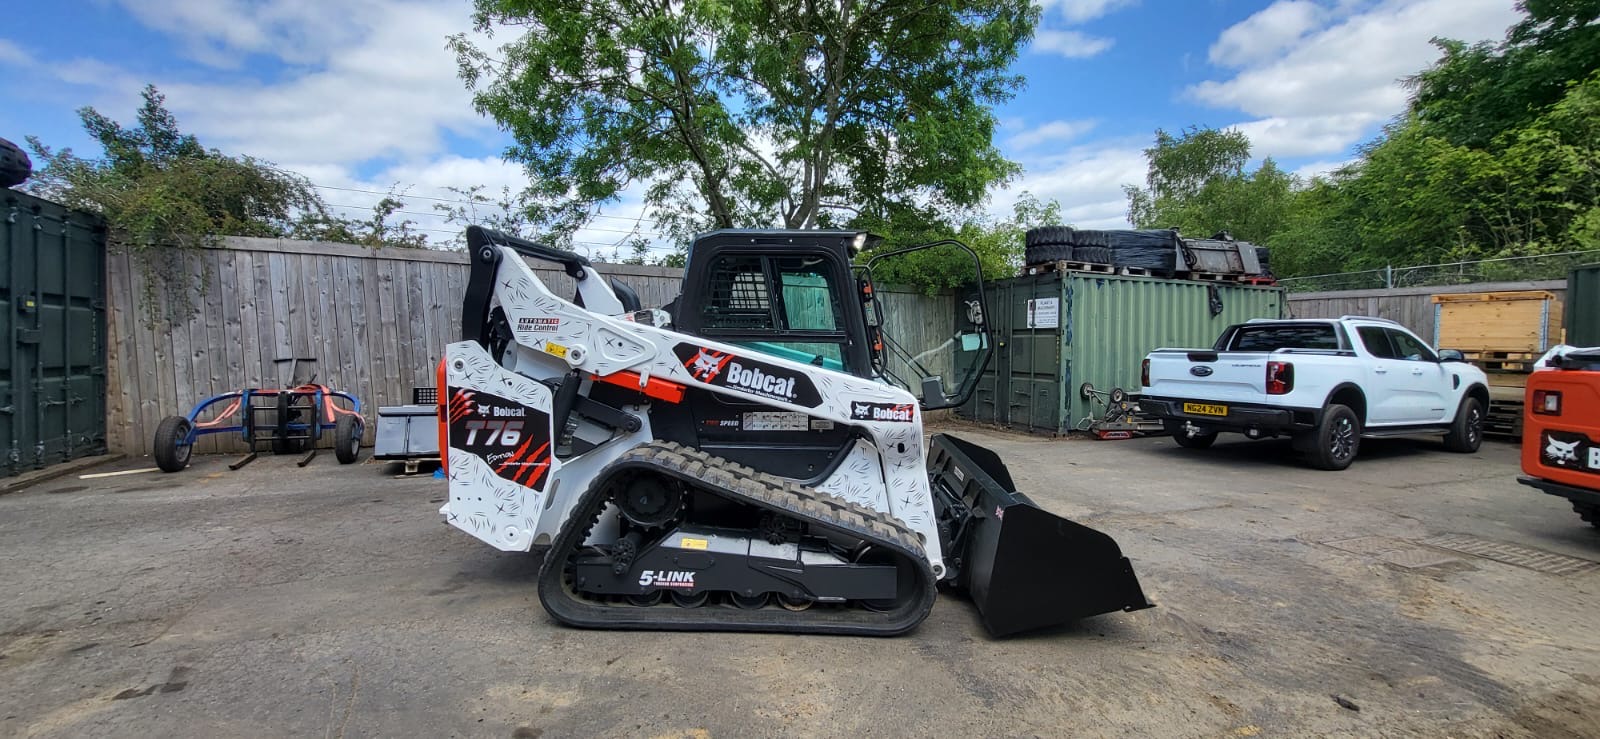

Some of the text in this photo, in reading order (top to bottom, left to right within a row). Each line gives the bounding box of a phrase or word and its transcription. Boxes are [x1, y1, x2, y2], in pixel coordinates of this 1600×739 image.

[726, 361, 796, 398] Bobcat
[493, 406, 525, 417] Bobcat
[873, 407, 912, 420] Bobcat
[1186, 404, 1224, 415] NG24 ZVN
[465, 420, 524, 446] T76
[638, 570, 696, 586] 5-LINK
